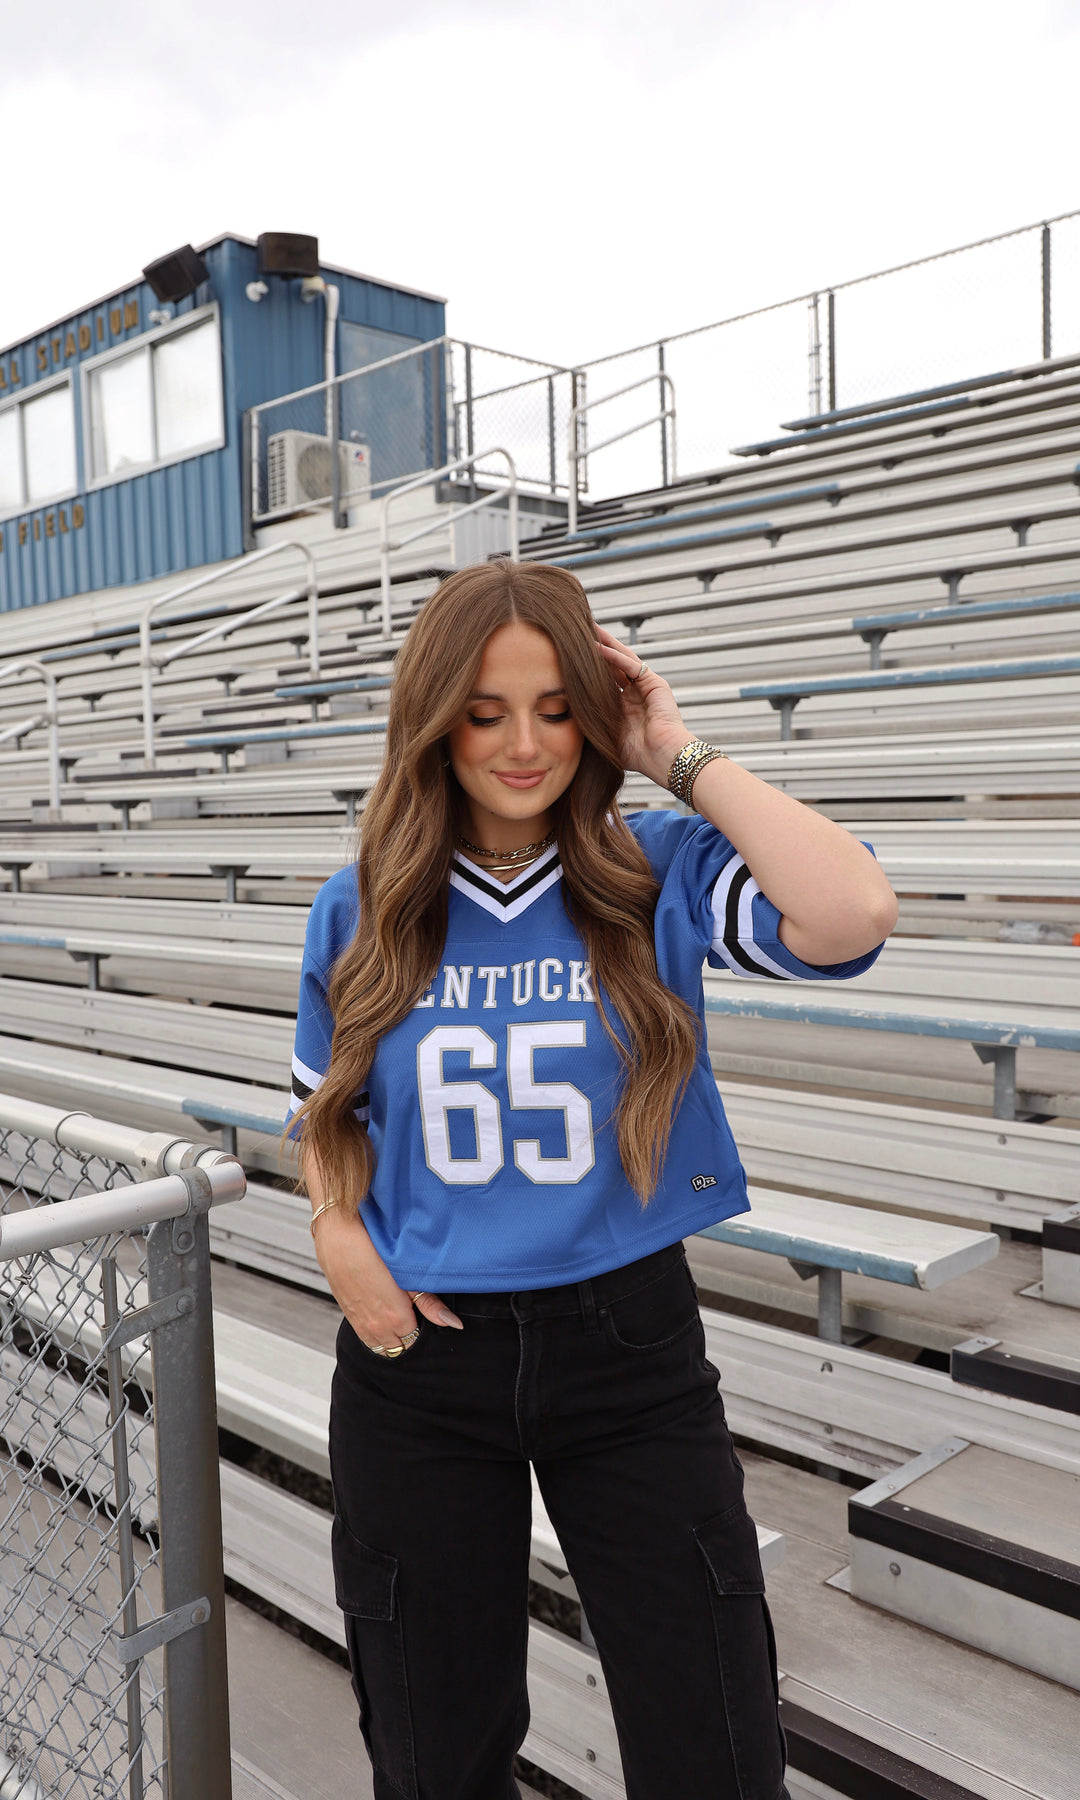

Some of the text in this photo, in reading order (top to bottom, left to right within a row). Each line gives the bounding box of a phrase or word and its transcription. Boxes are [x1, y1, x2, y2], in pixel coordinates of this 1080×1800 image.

[36, 299, 139, 371] STADIUM
[18, 504, 84, 546] FIELD
[412, 957, 599, 1009] NTUCK
[416, 1019, 596, 1185] 65
